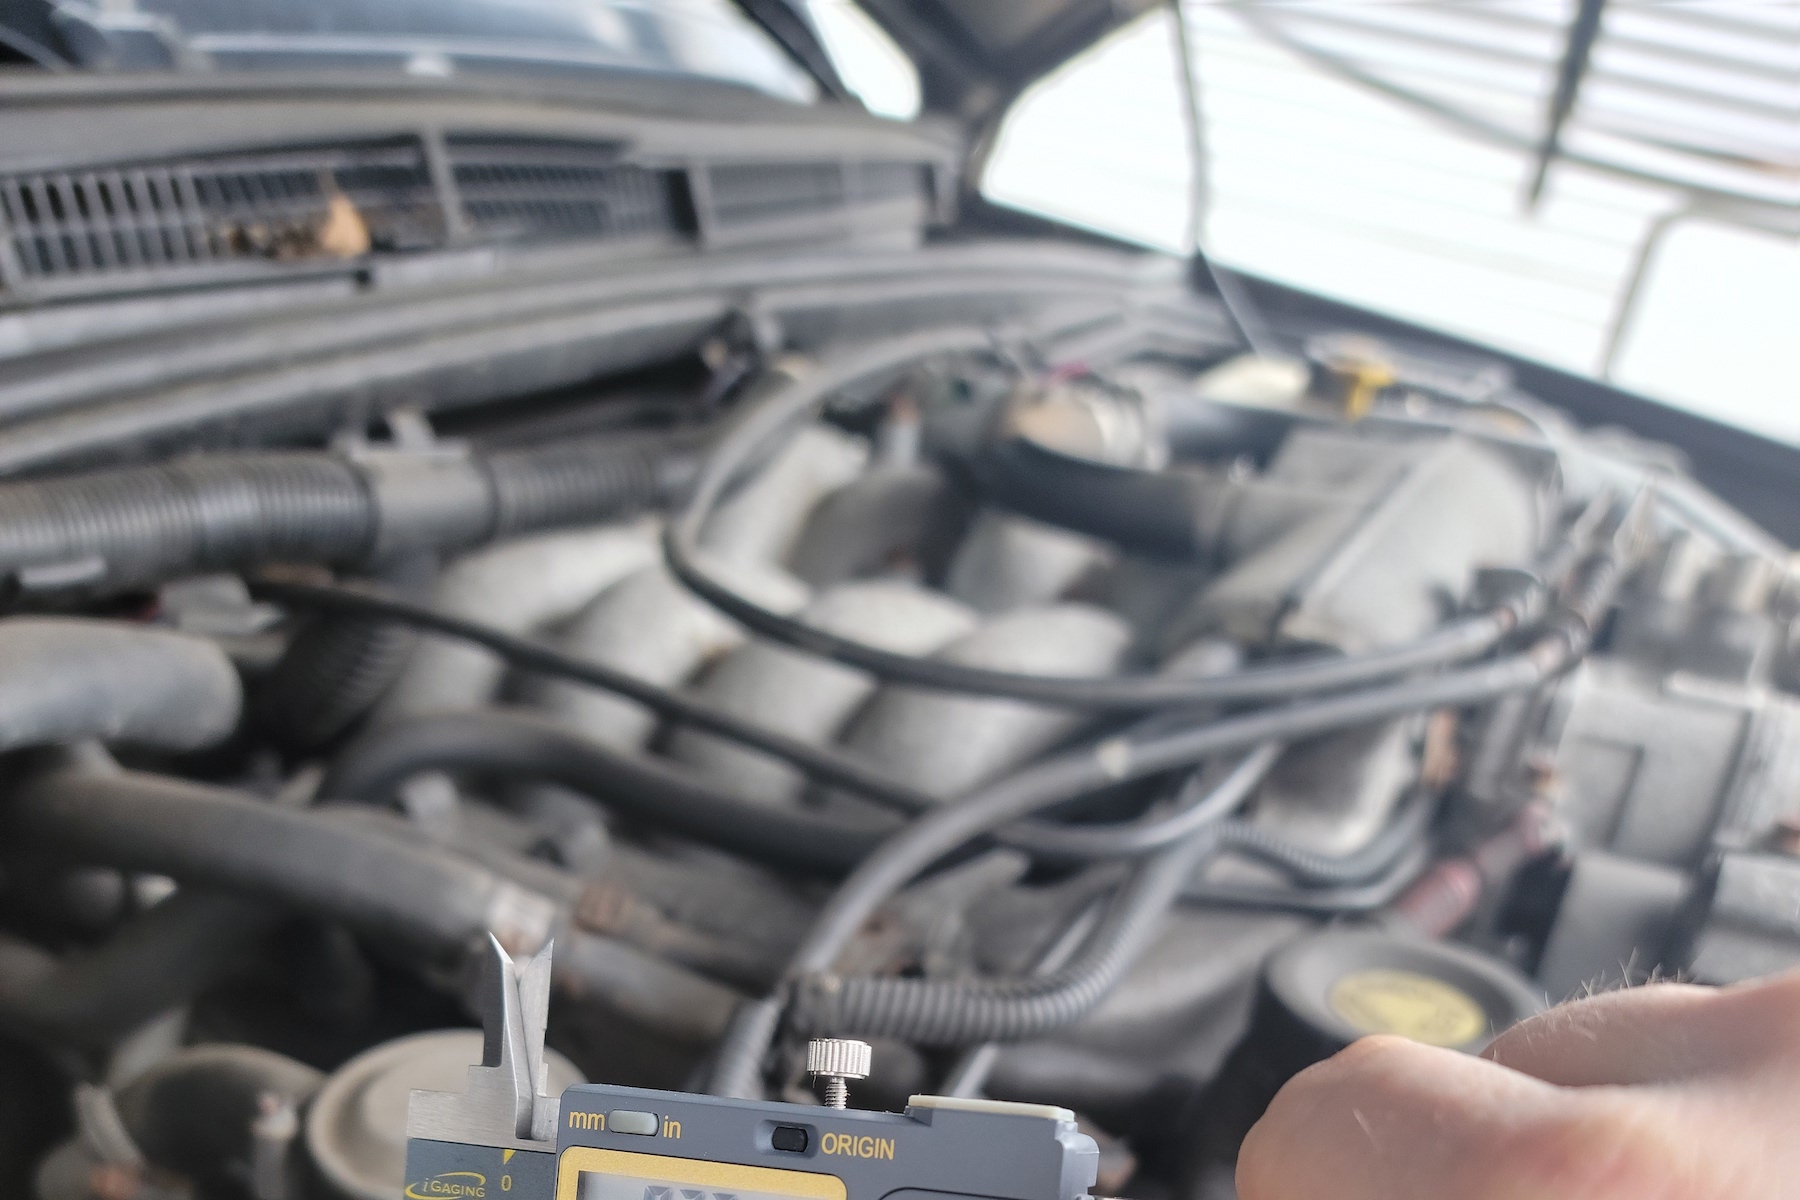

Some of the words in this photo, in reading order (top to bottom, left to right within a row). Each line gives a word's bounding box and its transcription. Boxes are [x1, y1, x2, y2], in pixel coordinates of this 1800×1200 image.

[569, 1111, 605, 1131] mm
[663, 1115, 681, 1139] in
[821, 1132, 895, 1160] ORIGIN
[501, 1175, 512, 1191] 0
